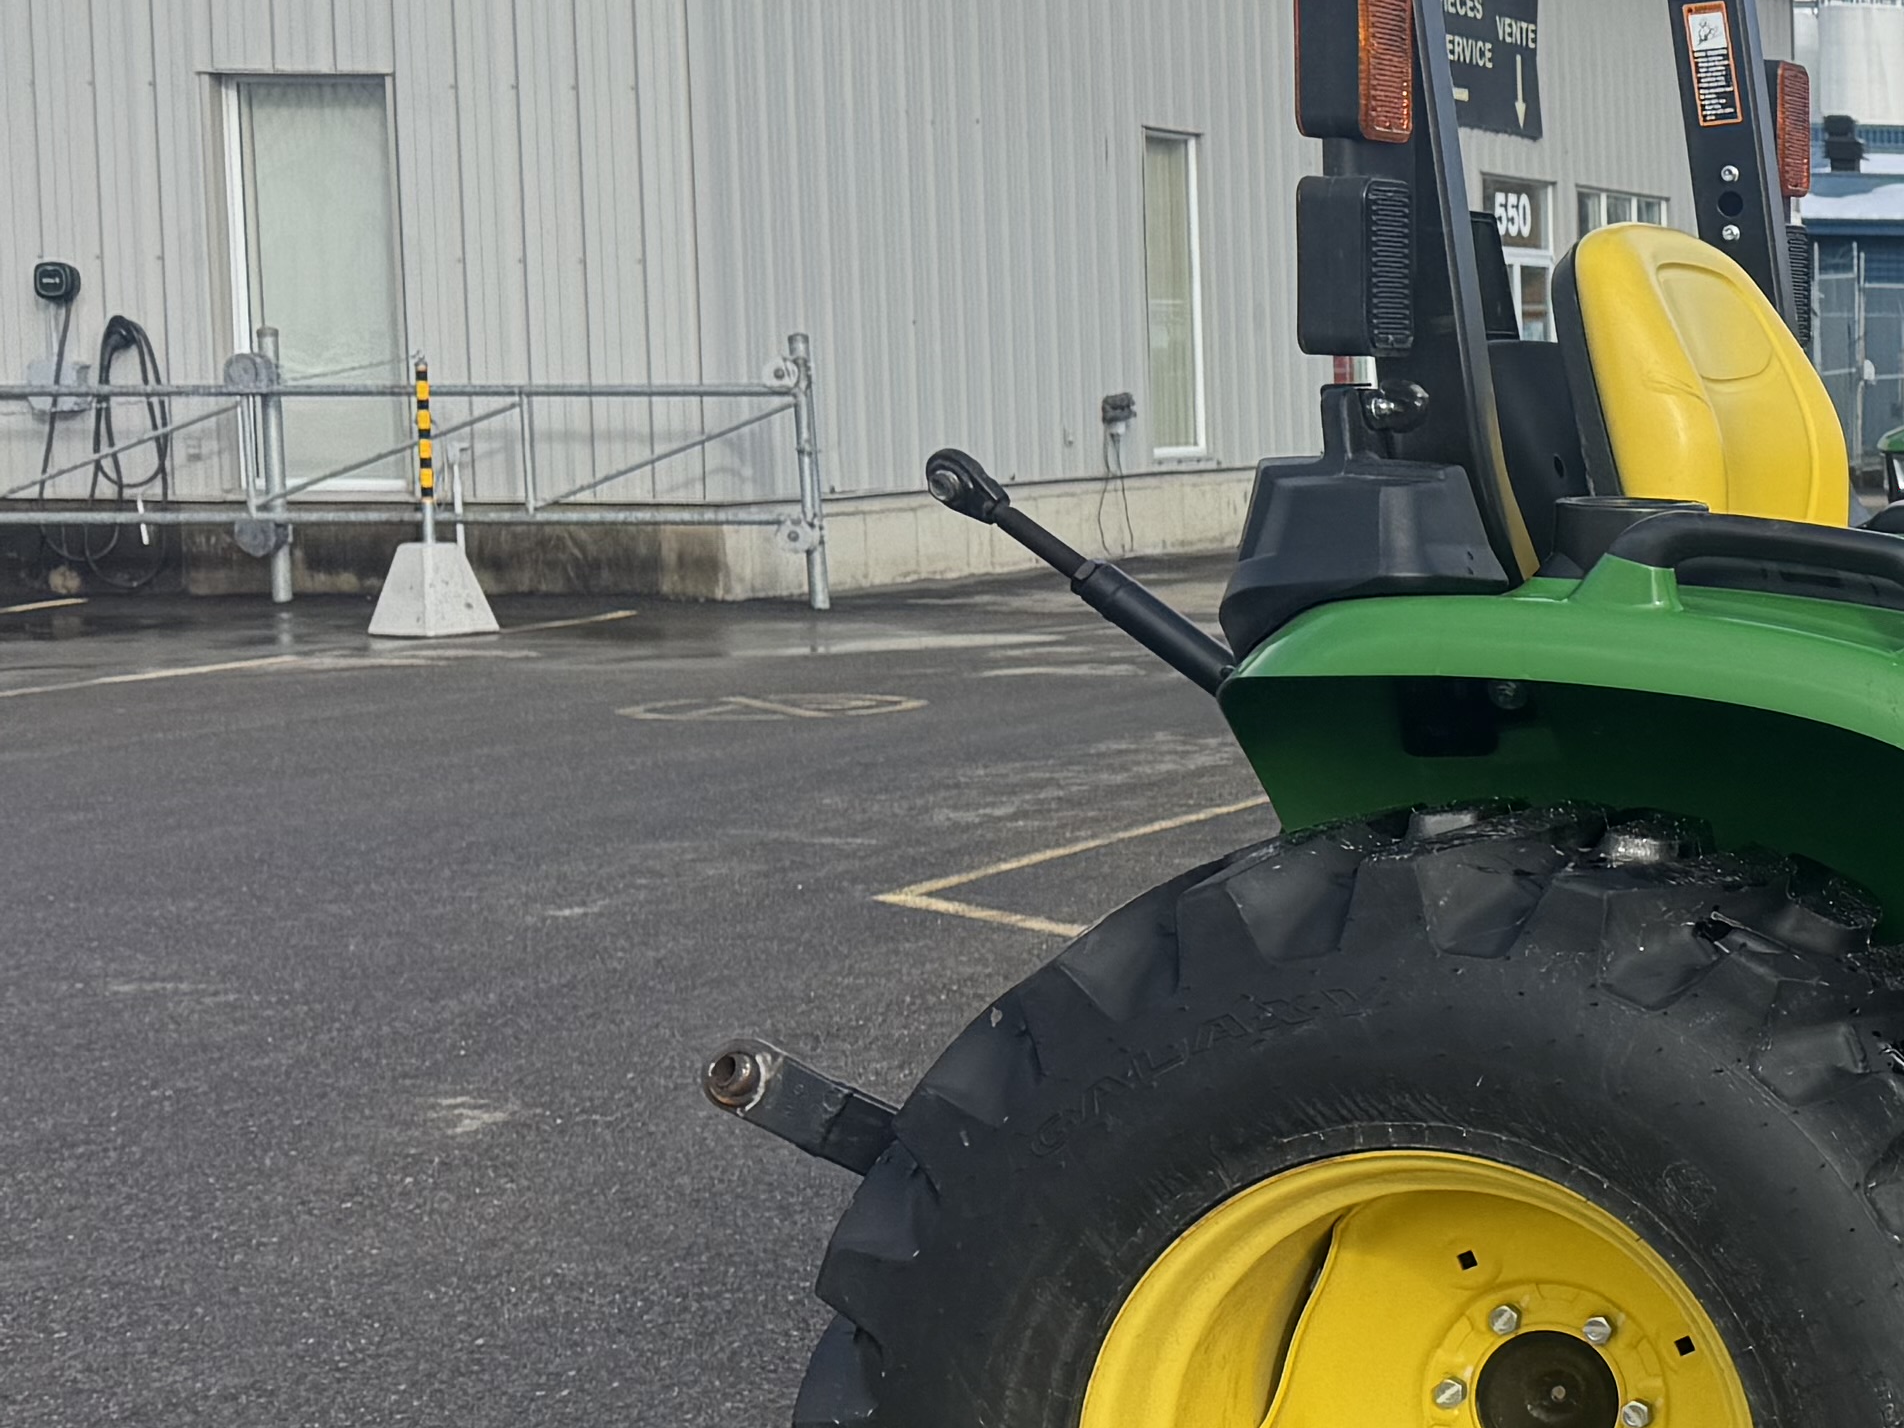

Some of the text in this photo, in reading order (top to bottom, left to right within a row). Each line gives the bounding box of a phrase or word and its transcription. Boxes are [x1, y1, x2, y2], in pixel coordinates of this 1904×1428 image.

[1495, 14, 1536, 49] VENTE
[1445, 33, 1493, 69] ERVICE
[1494, 191, 1532, 238] 550
